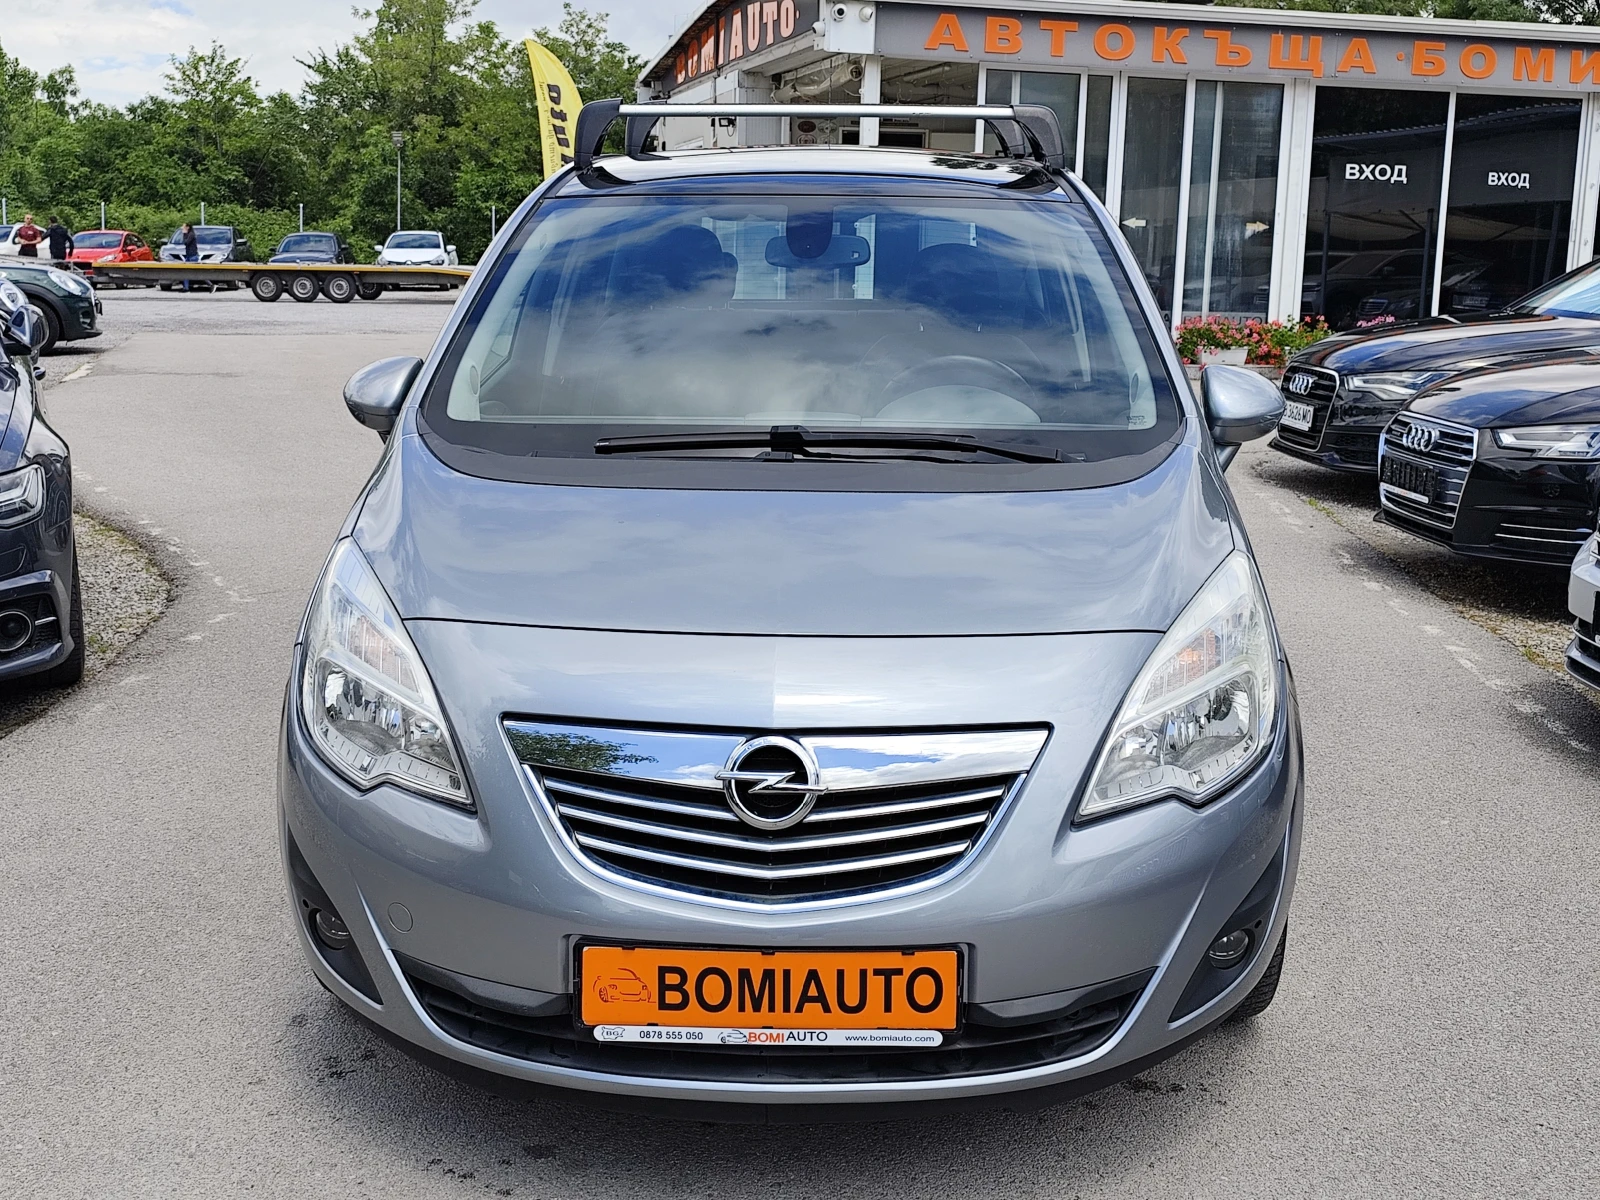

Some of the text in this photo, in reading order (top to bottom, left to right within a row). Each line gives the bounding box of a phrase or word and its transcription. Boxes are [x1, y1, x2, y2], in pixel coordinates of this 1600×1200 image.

[674, 0, 796, 85] BOMIAUTO
[923, 12, 1600, 84] АВТОКЪЩА БОМИ
[1344, 163, 1408, 184] ВХОД
[1487, 171, 1530, 189] ВХОД
[657, 965, 944, 1014] BOMIAUTO
[639, 1030, 704, 1040] 0878 555 050
[844, 1034, 935, 1042] www.bomiauto.com
